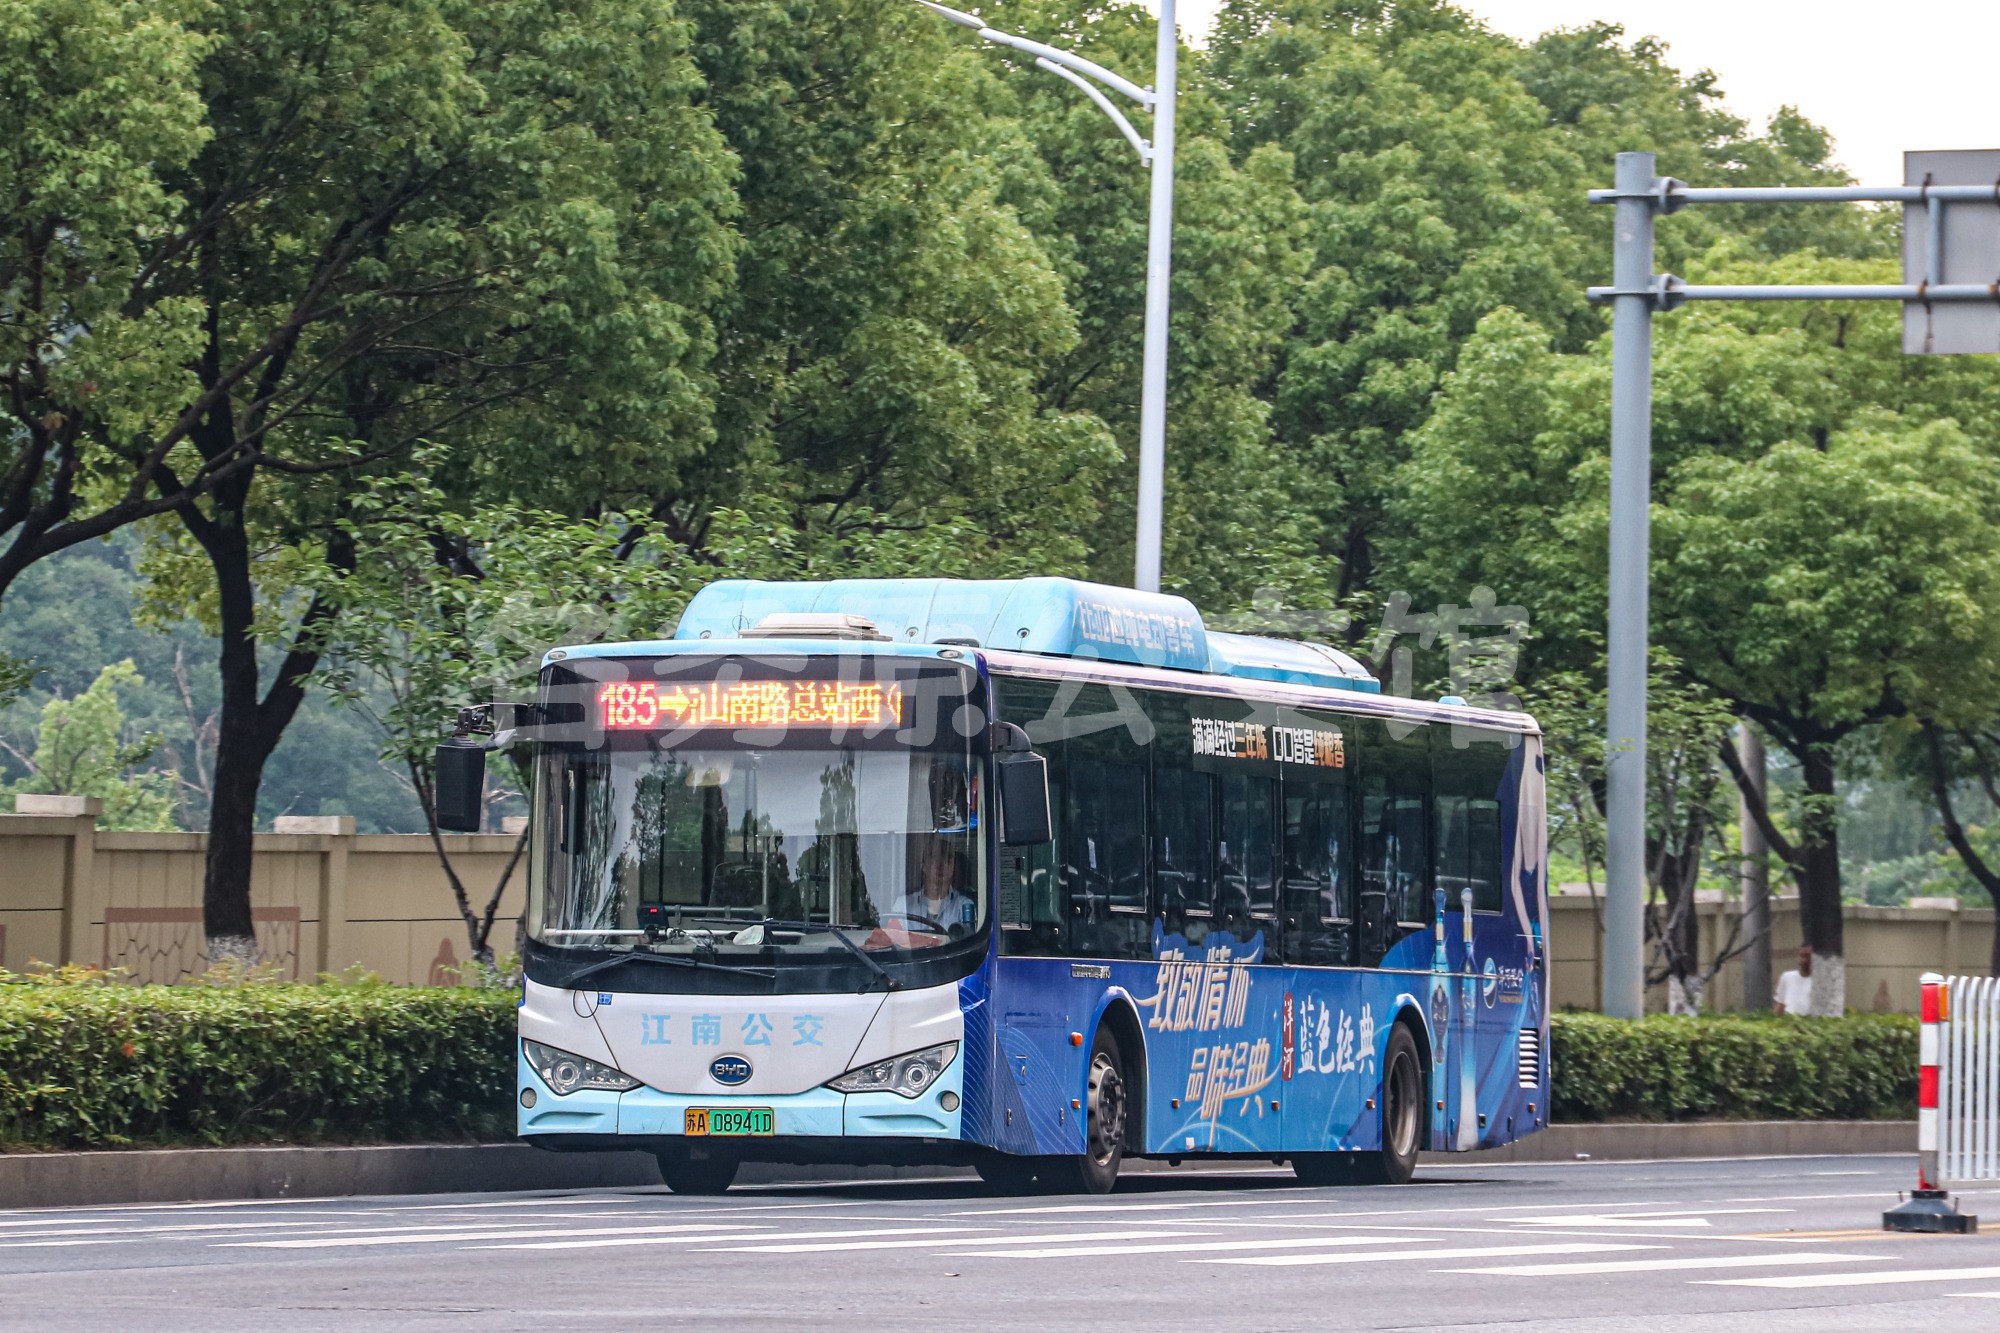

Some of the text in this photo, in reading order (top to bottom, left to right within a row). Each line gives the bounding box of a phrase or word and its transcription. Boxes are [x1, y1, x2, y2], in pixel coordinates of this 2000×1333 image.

[600, 683, 658, 726] 185
[640, 1013, 825, 1047] 江南公交
[714, 1063, 748, 1076] BYD
